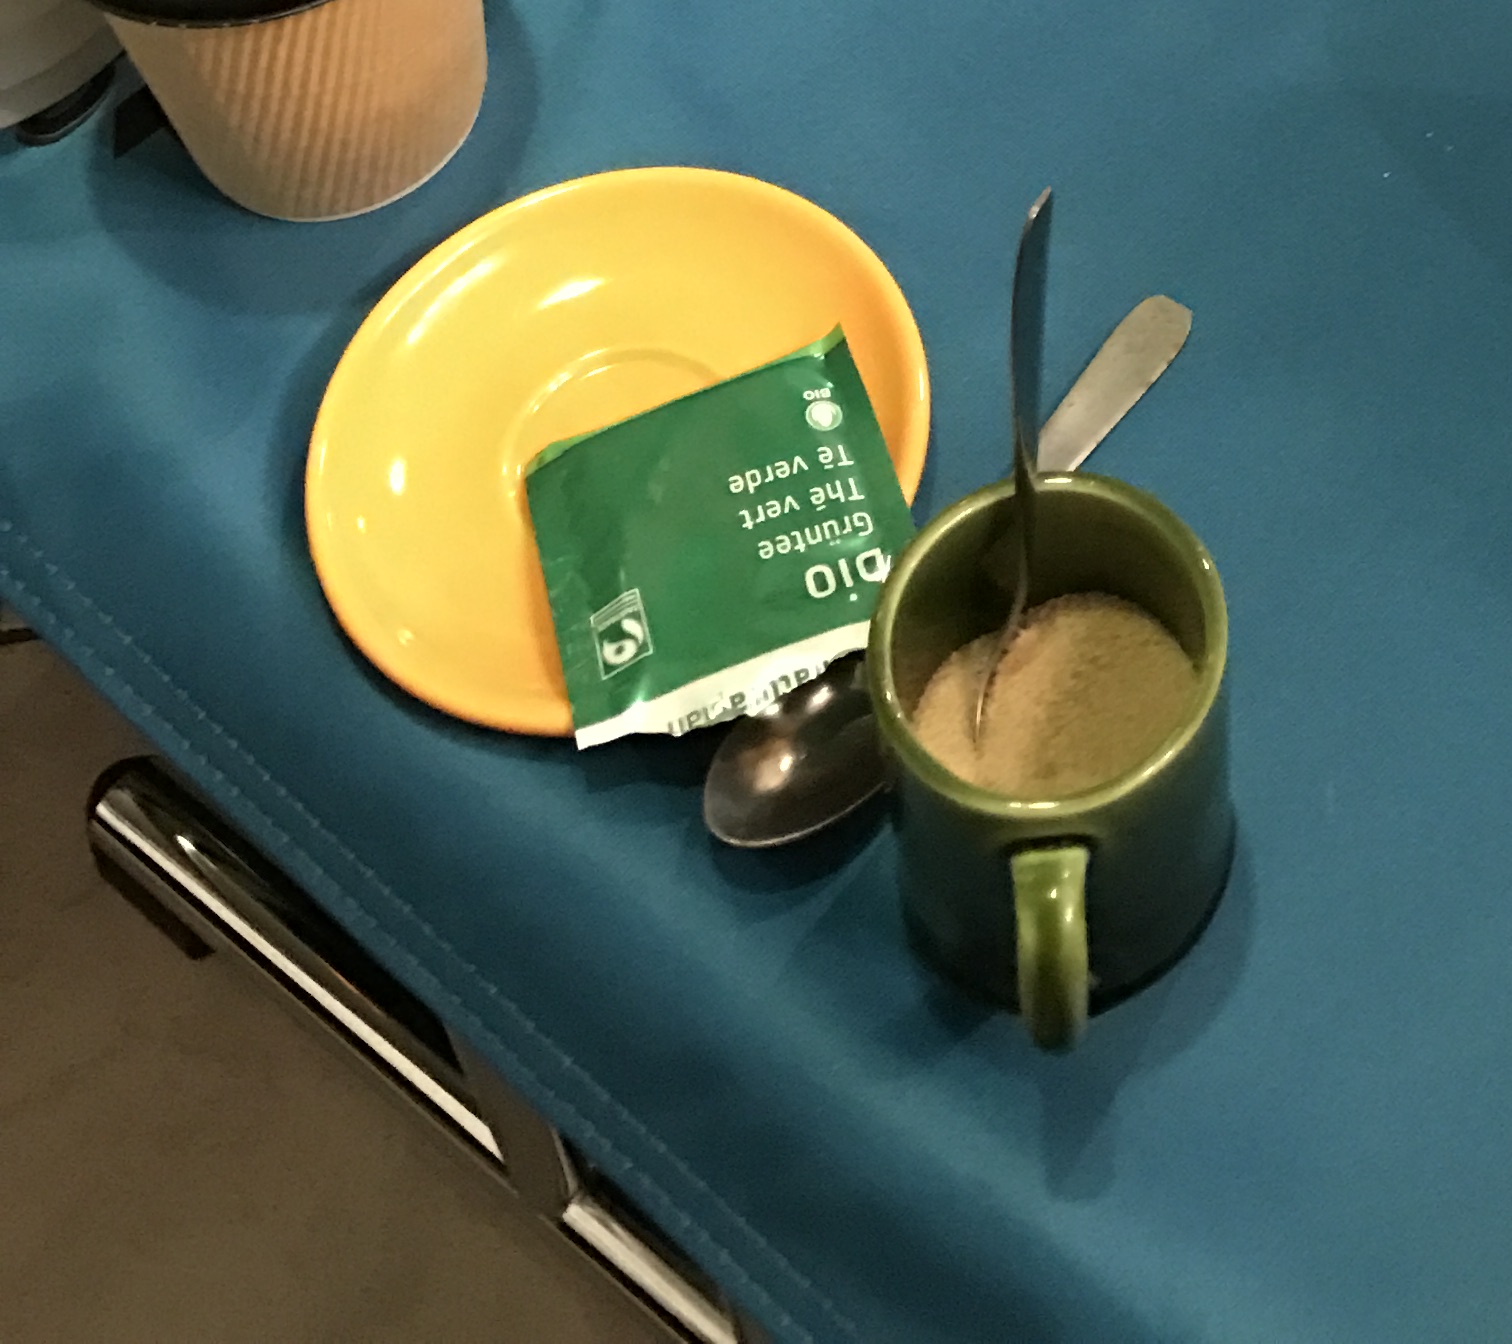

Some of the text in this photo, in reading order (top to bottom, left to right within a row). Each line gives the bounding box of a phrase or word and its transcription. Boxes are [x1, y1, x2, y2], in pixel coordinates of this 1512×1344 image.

[802, 387, 832, 400] BIO
[728, 455, 809, 494] verde
[738, 495, 800, 530] vert
[757, 512, 874, 560] Grüntee
